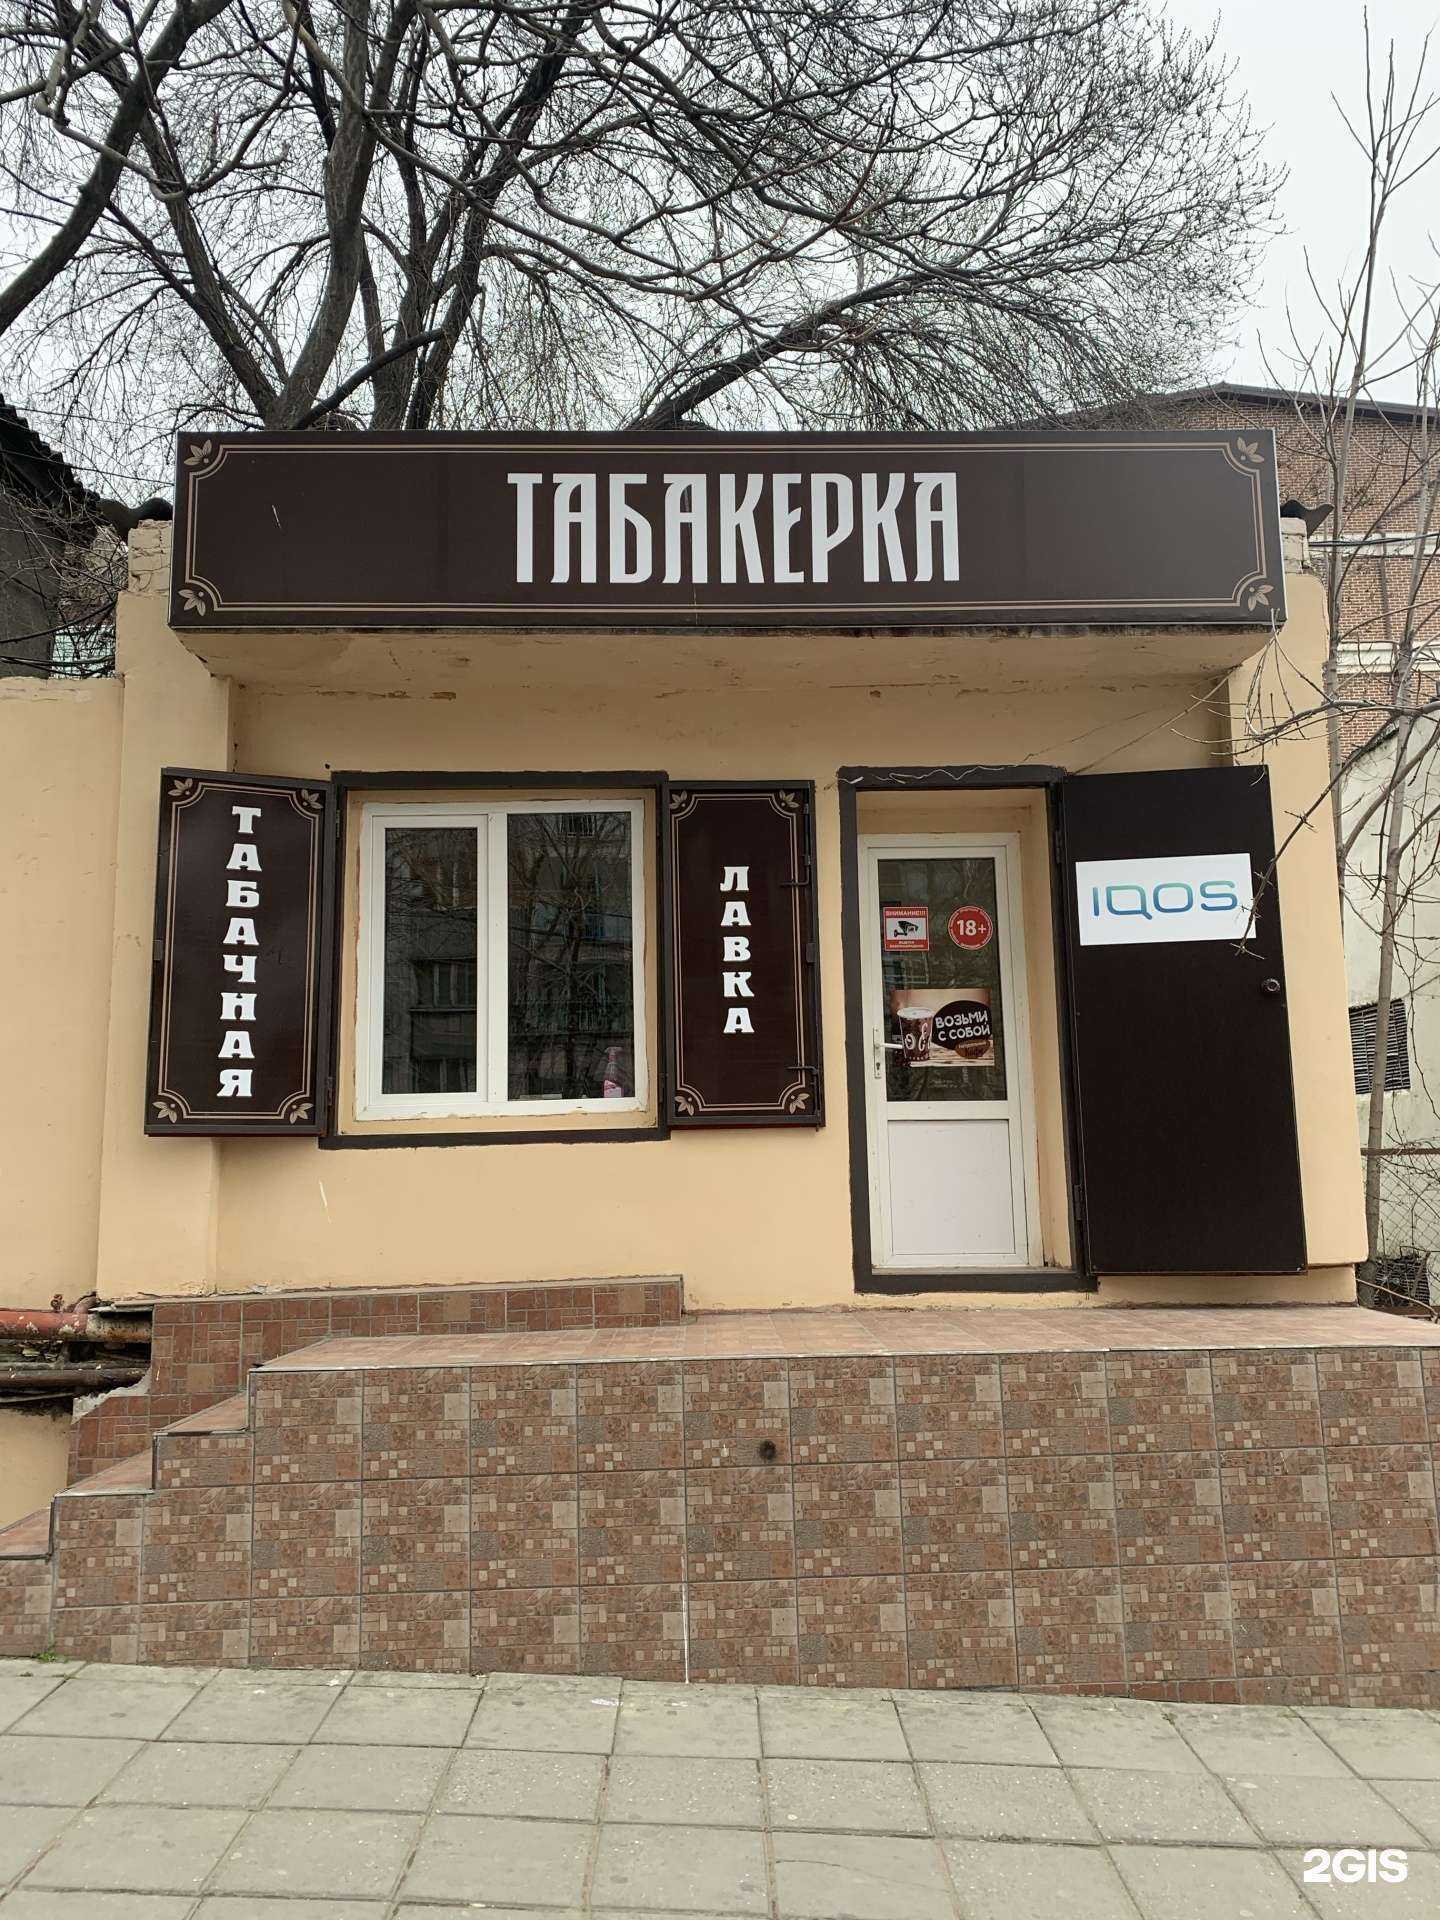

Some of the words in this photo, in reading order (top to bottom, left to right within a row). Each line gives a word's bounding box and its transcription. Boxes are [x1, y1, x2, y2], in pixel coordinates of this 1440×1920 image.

[507, 472, 960, 584] ТАБАКЕРКА
[1092, 880, 1238, 920] IQOS
[956, 919, 987, 936] 18+
[216, 805, 263, 1097] ТАБАЧНАЯ
[719, 866, 755, 1034] ЛАВКА
[935, 1010, 988, 1029] ВОЗЬМИ
[938, 1030, 947, 1041] С
[949, 1022, 991, 1040] СОБОЙ
